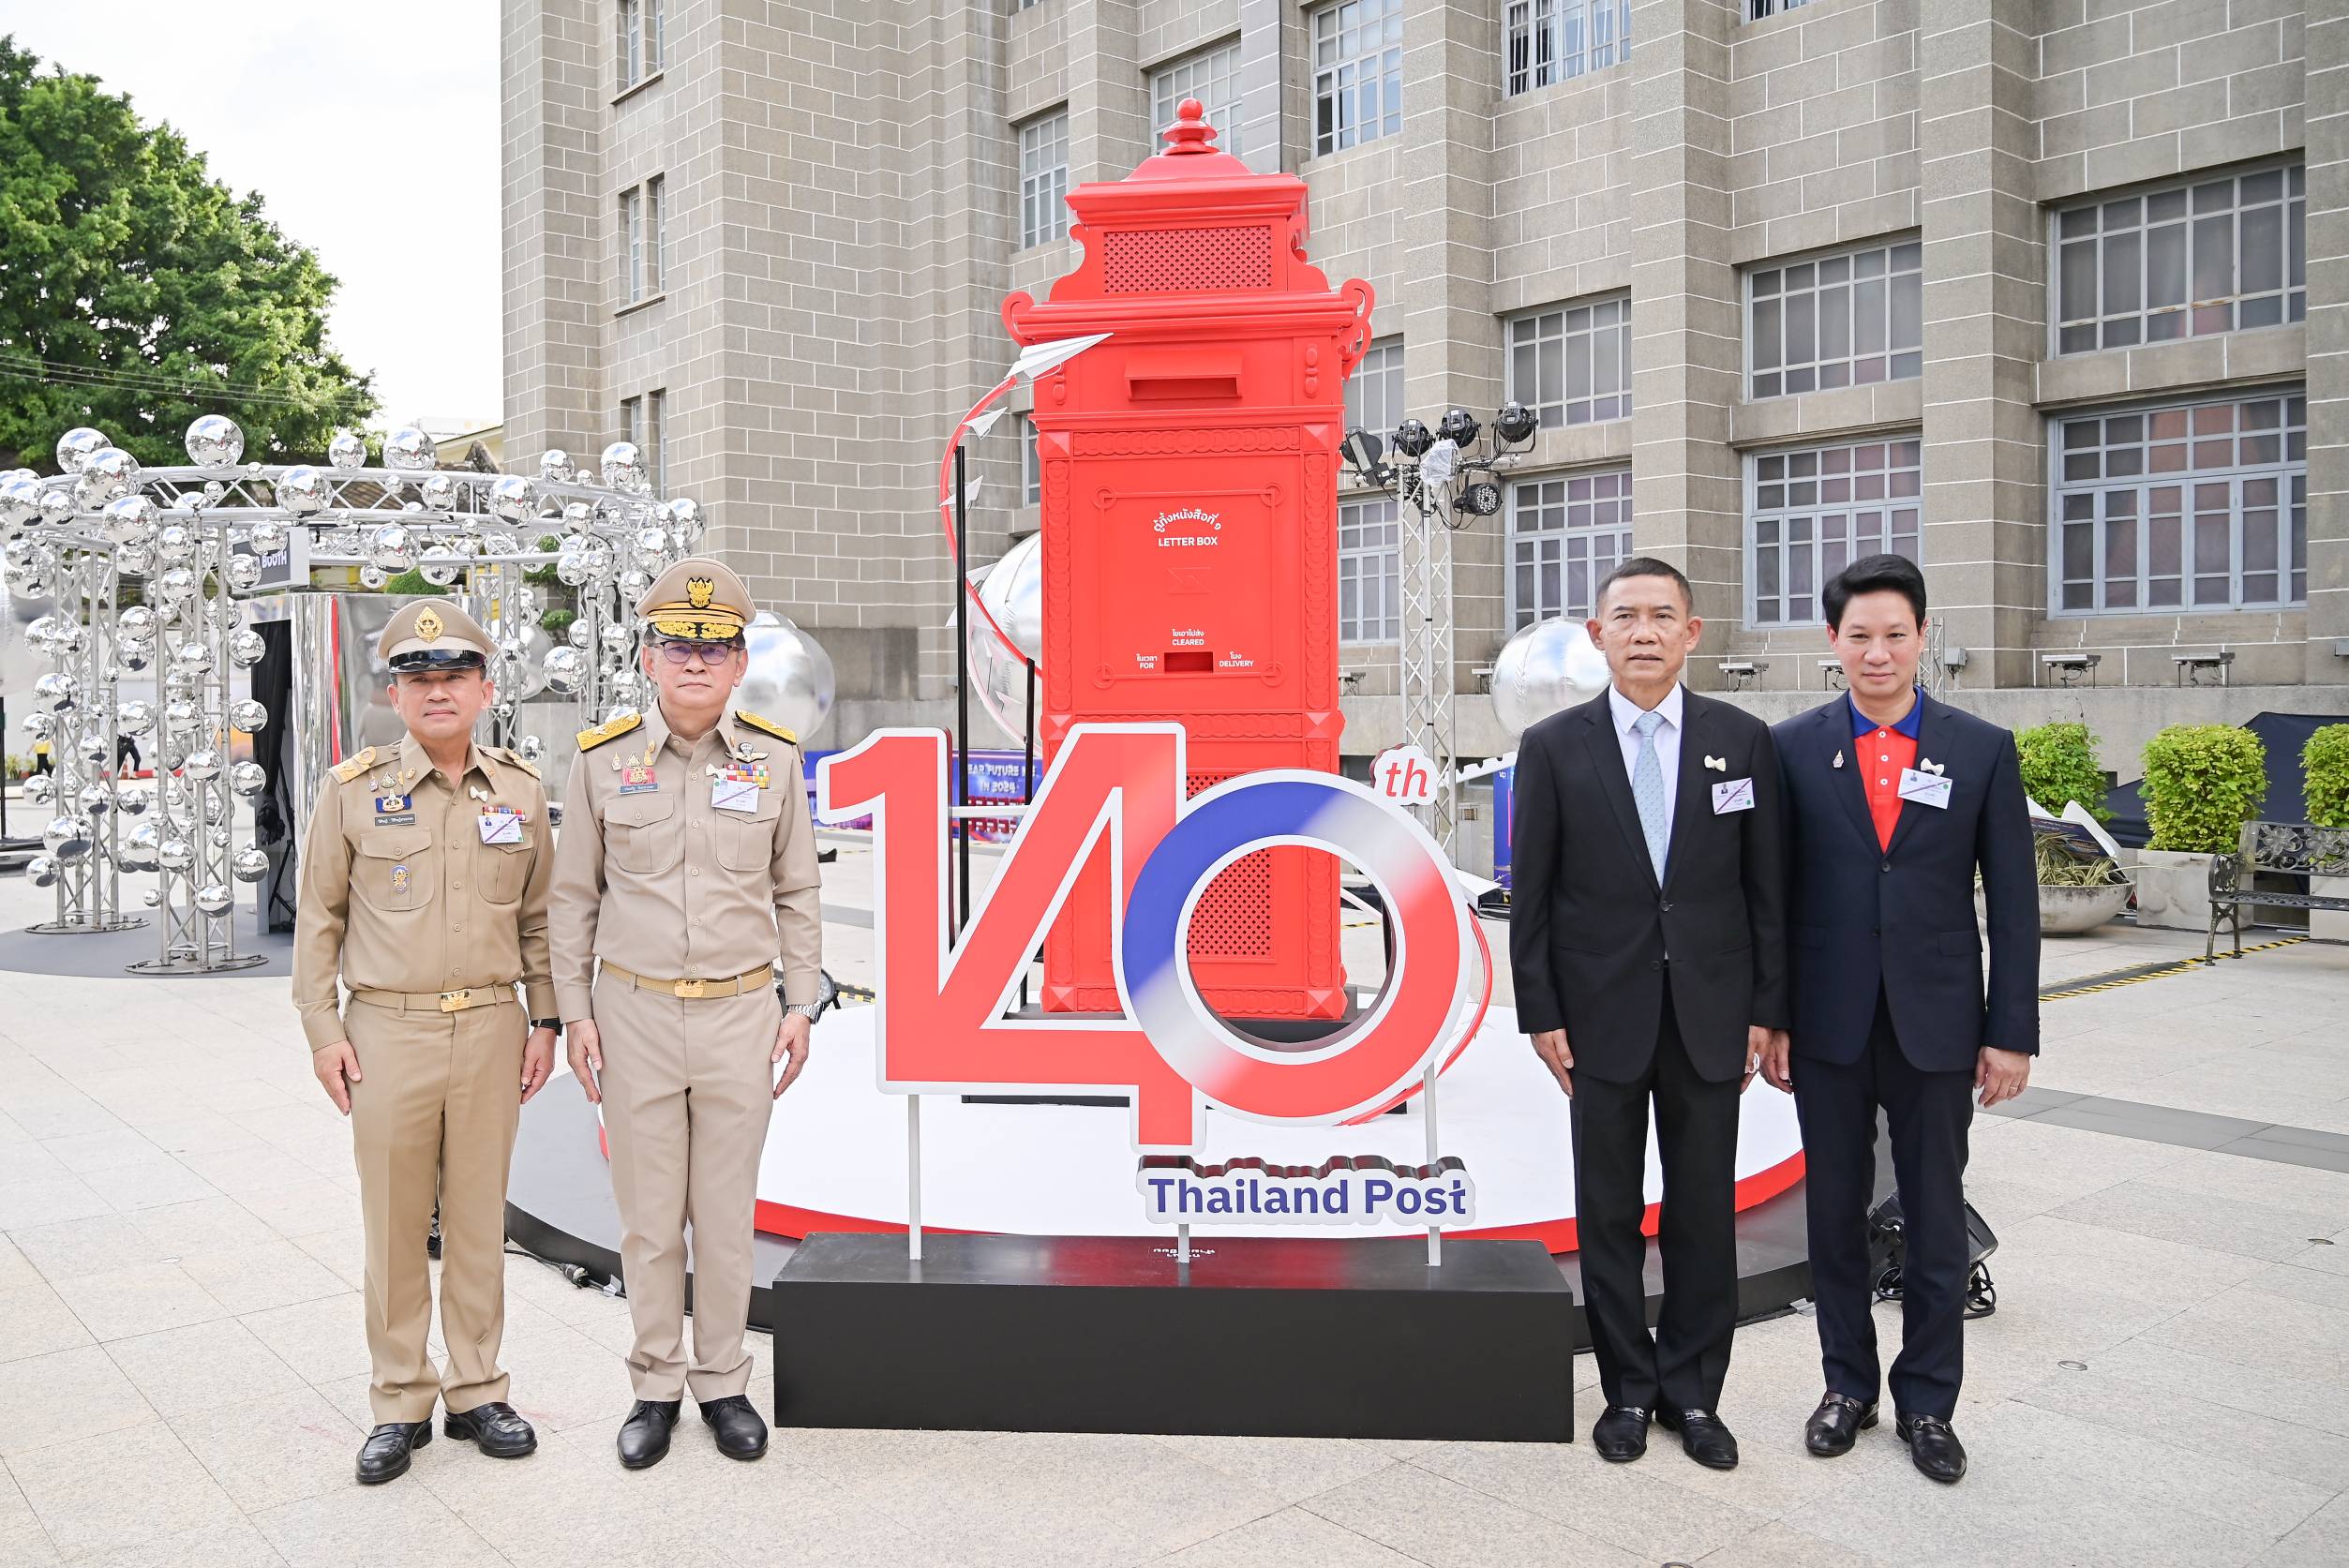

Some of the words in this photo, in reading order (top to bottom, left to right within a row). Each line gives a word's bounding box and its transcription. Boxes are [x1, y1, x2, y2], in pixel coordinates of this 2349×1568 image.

[1158, 537, 1195, 547] LETTER
[1196, 536, 1219, 546] BOX
[262, 550, 287, 569] BOOTH
[967, 764, 985, 776] EAR
[987, 764, 1019, 777] FUTURE
[992, 781, 1016, 794] 2024
[830, 733, 1459, 1145] 140
[1385, 758, 1428, 798] th
[1147, 1178, 1349, 1214] Thailand
[1365, 1179, 1466, 1215] Post
